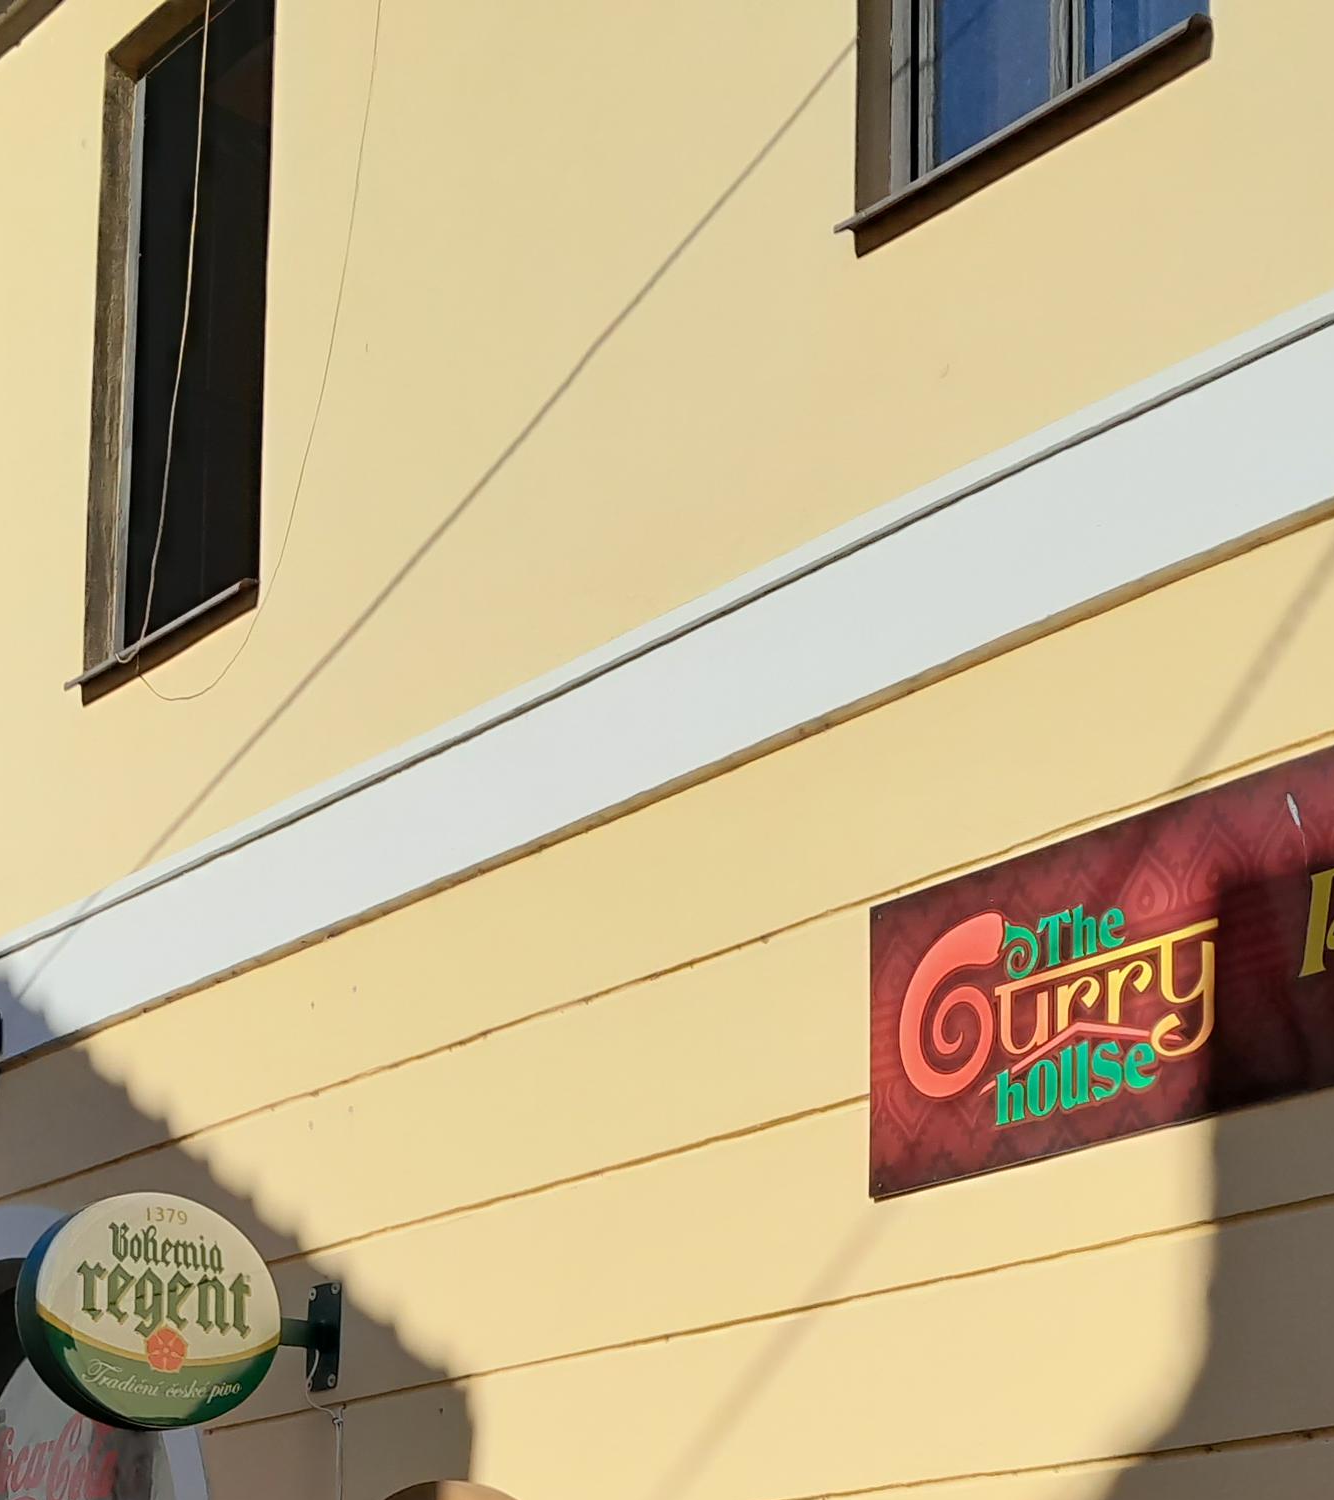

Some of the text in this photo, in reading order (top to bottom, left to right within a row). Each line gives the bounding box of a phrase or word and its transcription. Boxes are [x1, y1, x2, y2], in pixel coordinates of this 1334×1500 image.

[1036, 904, 1126, 968] The
[898, 911, 1219, 1099] Curry
[995, 1039, 1158, 1126] house
[108, 1222, 224, 1274] Bohemia
[145, 1206, 189, 1226] 1379
[76, 1260, 253, 1339] regent
[205, 1380, 243, 1404] pivo
